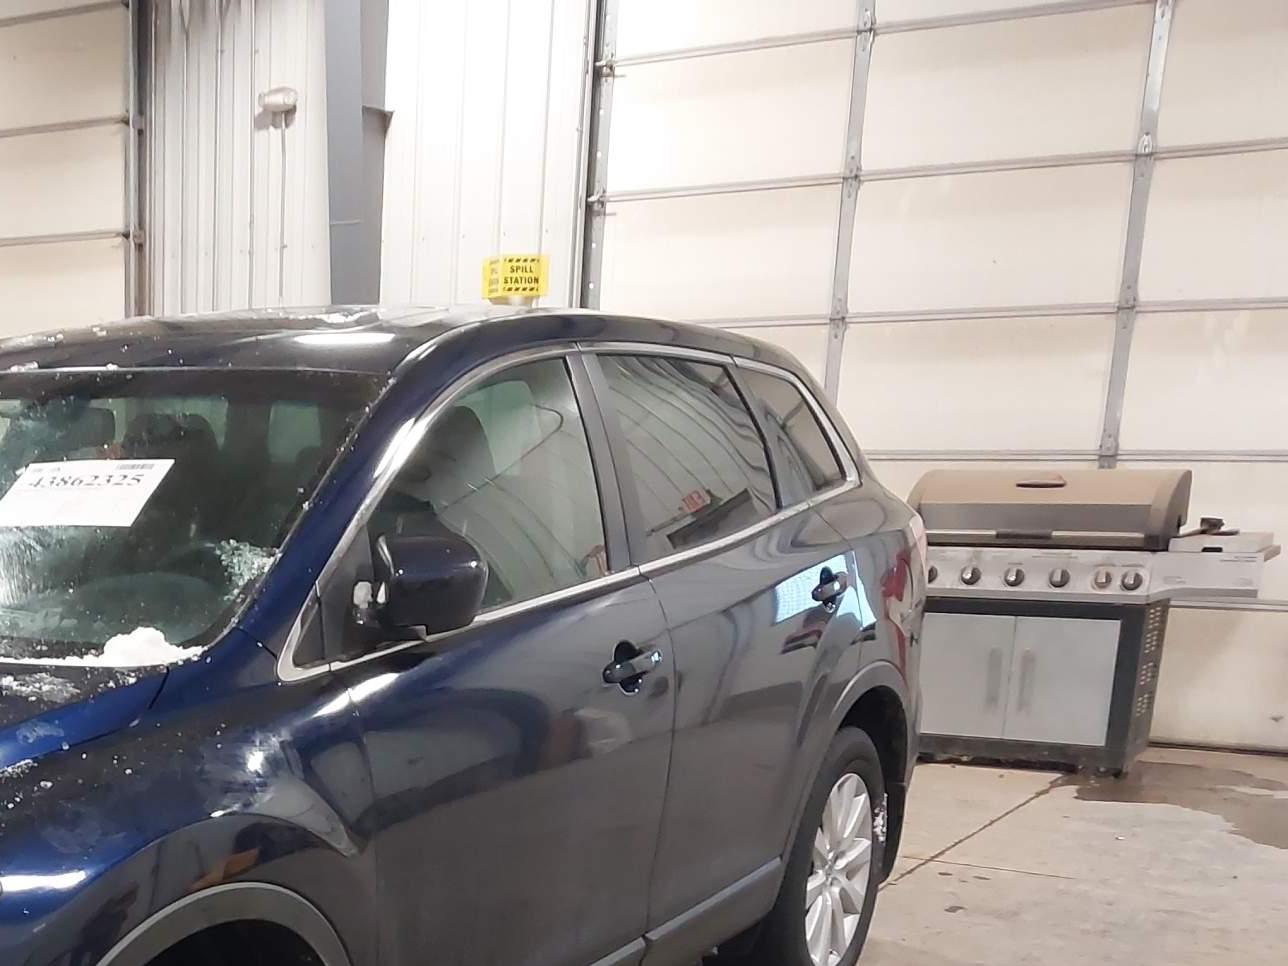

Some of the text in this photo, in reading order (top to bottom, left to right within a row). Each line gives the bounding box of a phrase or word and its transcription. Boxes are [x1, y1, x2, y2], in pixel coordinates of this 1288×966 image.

[509, 265, 534, 273] SPILL
[503, 276, 539, 285] STATION
[28, 474, 145, 488] 43862325
